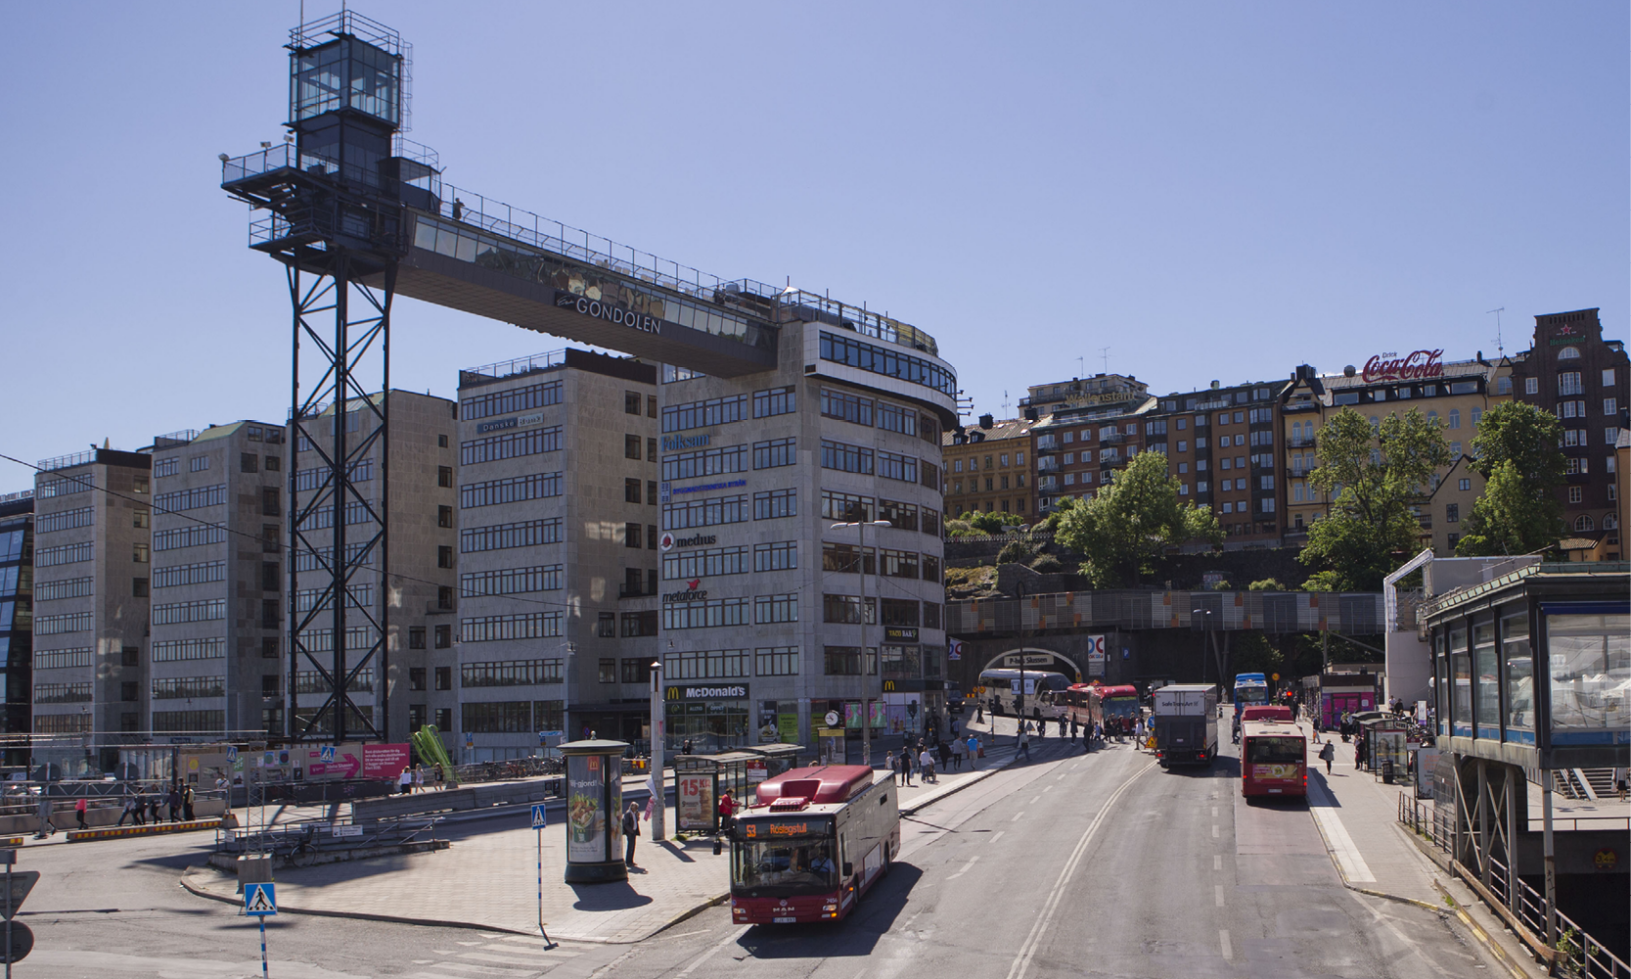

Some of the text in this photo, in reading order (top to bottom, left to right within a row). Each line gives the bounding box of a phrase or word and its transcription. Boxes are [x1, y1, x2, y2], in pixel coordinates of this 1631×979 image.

[577, 297, 661, 334] GONDOLEN
[1362, 348, 1445, 383] Coca-Cola
[483, 420, 515, 431] Danske
[661, 434, 710, 452] Folksam
[676, 533, 716, 548] medius
[662, 588, 708, 602] metaforce
[888, 629, 902, 637] TACO
[686, 686, 745, 698] McDonald's
[681, 779, 699, 796] 15
[746, 823, 807, 837] 53 Roslagstull
